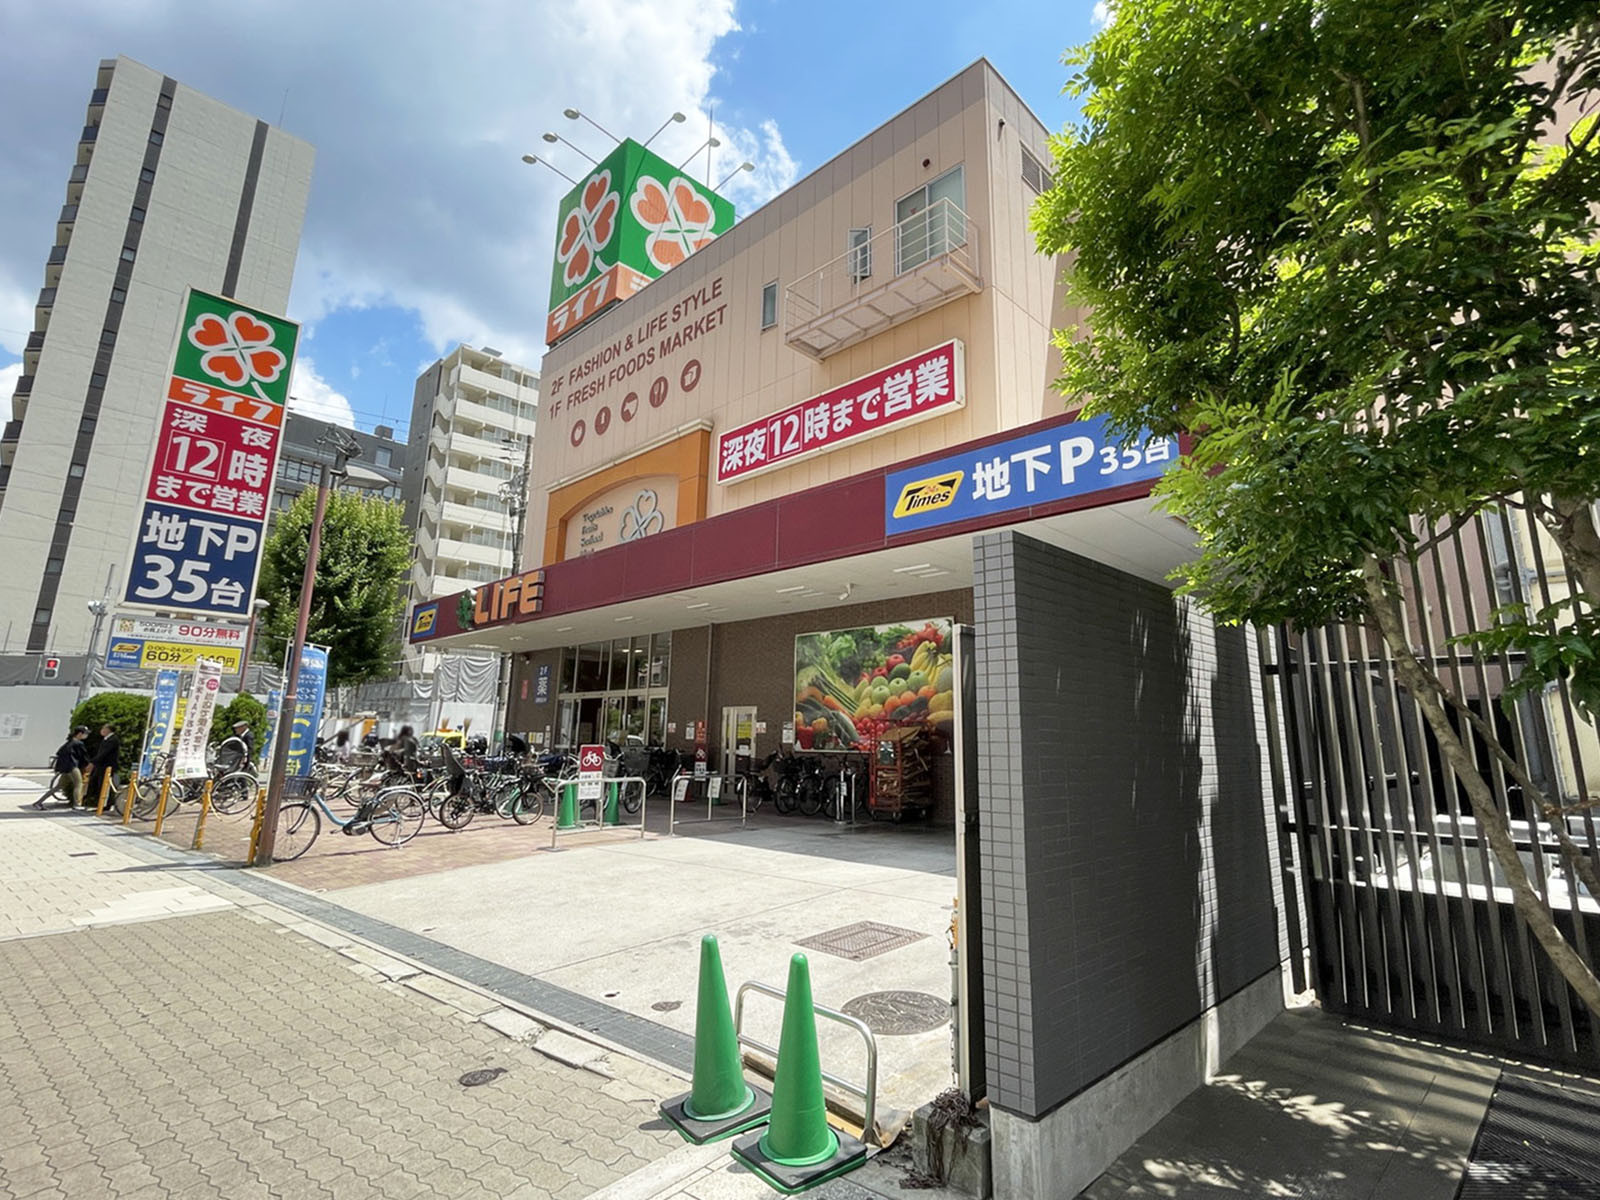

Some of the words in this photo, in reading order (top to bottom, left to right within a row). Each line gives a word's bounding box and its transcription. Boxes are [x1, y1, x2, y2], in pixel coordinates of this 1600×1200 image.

[552, 274, 610, 333] ライフ
[549, 399, 562, 420] 1F
[566, 375, 606, 411] FRESH
[608, 346, 656, 388] FOODS
[658, 304, 728, 359] MARKET
[551, 375, 564, 396] 2F
[568, 342, 622, 386] FASHION
[624, 333, 635, 352] &
[637, 312, 668, 345] LIFE
[671, 277, 723, 324] STYLE
[170, 407, 274, 450] 深夜
[181, 382, 276, 421] ライフ
[721, 354, 950, 475] 深夜12時まで営業
[155, 475, 265, 516] まで営業
[905, 487, 951, 512] Times
[142, 510, 258, 561] 地下P
[134, 554, 246, 608] 35台
[474, 571, 544, 625] LIFE
